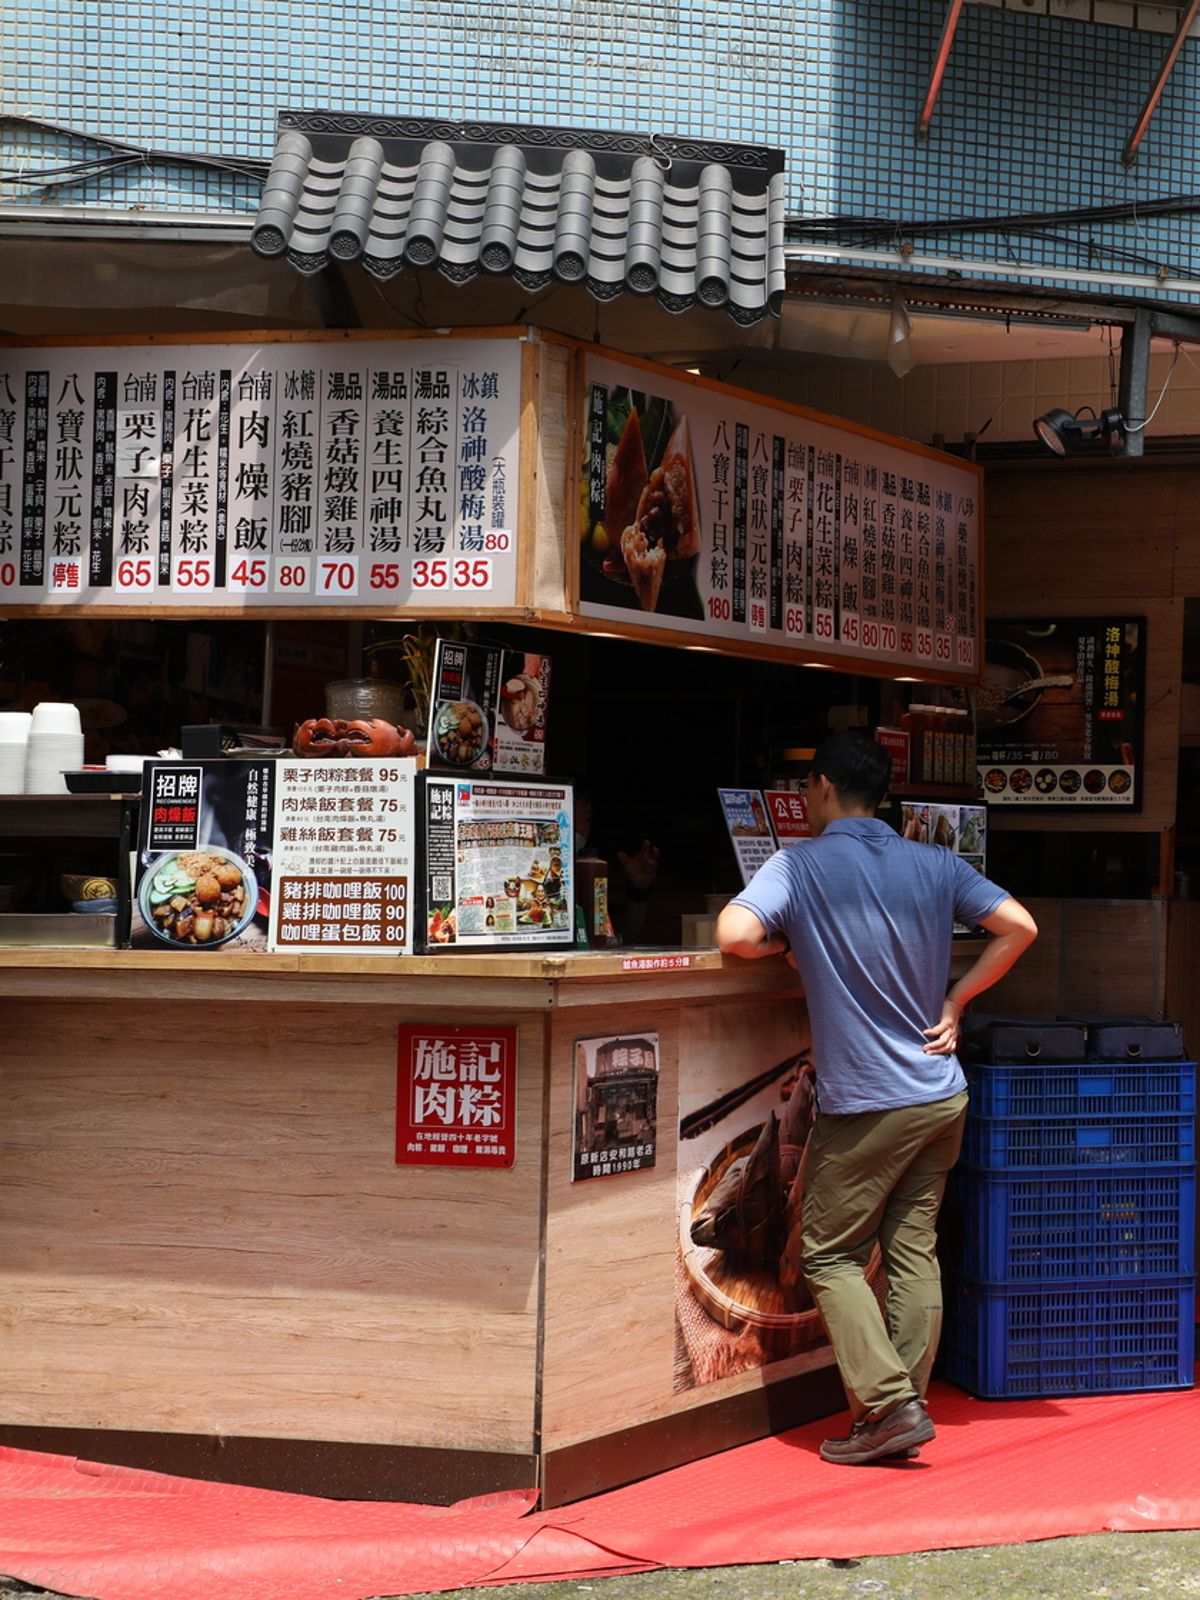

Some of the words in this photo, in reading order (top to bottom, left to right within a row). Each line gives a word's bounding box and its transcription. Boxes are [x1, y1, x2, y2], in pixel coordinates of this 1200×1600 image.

[52, 372, 85, 556] 八寶狀元粽
[710, 420, 730, 591] 八寶干貝粽
[750, 433, 769, 599] 八寶狀元粽
[485, 534, 509, 550] 80
[52, 562, 79, 588] 停售
[118, 560, 151, 587] 65
[176, 560, 210, 587] 55
[231, 560, 266, 587] 45
[279, 566, 306, 586] 80
[322, 563, 355, 589] 70
[370, 564, 399, 588] 55
[412, 560, 447, 587] 35
[453, 560, 489, 587] 35
[708, 597, 730, 620] 180
[786, 609, 804, 632] 65
[816, 614, 832, 637] 55
[842, 617, 858, 641] 45
[862, 623, 878, 646] 80
[880, 627, 896, 649] 70
[918, 632, 931, 654] 35
[443, 651, 464, 666] 招牌
[936, 637, 950, 659] 35
[958, 641, 973, 664] 180
[1104, 627, 1121, 707] 洛神酸梅湯
[156, 774, 198, 798] 招牌
[283, 768, 374, 783] 栗子肉粽套餐
[154, 807, 196, 824] 肉燥飯
[281, 798, 374, 812] 肉燥飯套餐
[774, 798, 804, 820] 公告
[280, 827, 374, 842] 雞絲飯套餐
[283, 882, 382, 900] 豬排咖哩飯
[383, 884, 405, 900] 100
[282, 903, 382, 921] 雞排咖哩飯
[386, 905, 405, 920] 90
[281, 924, 381, 942] 咖哩蛋包飯
[386, 926, 405, 941] 80
[413, 1039, 502, 1083] 施記
[414, 1082, 502, 1127] 肉粽
